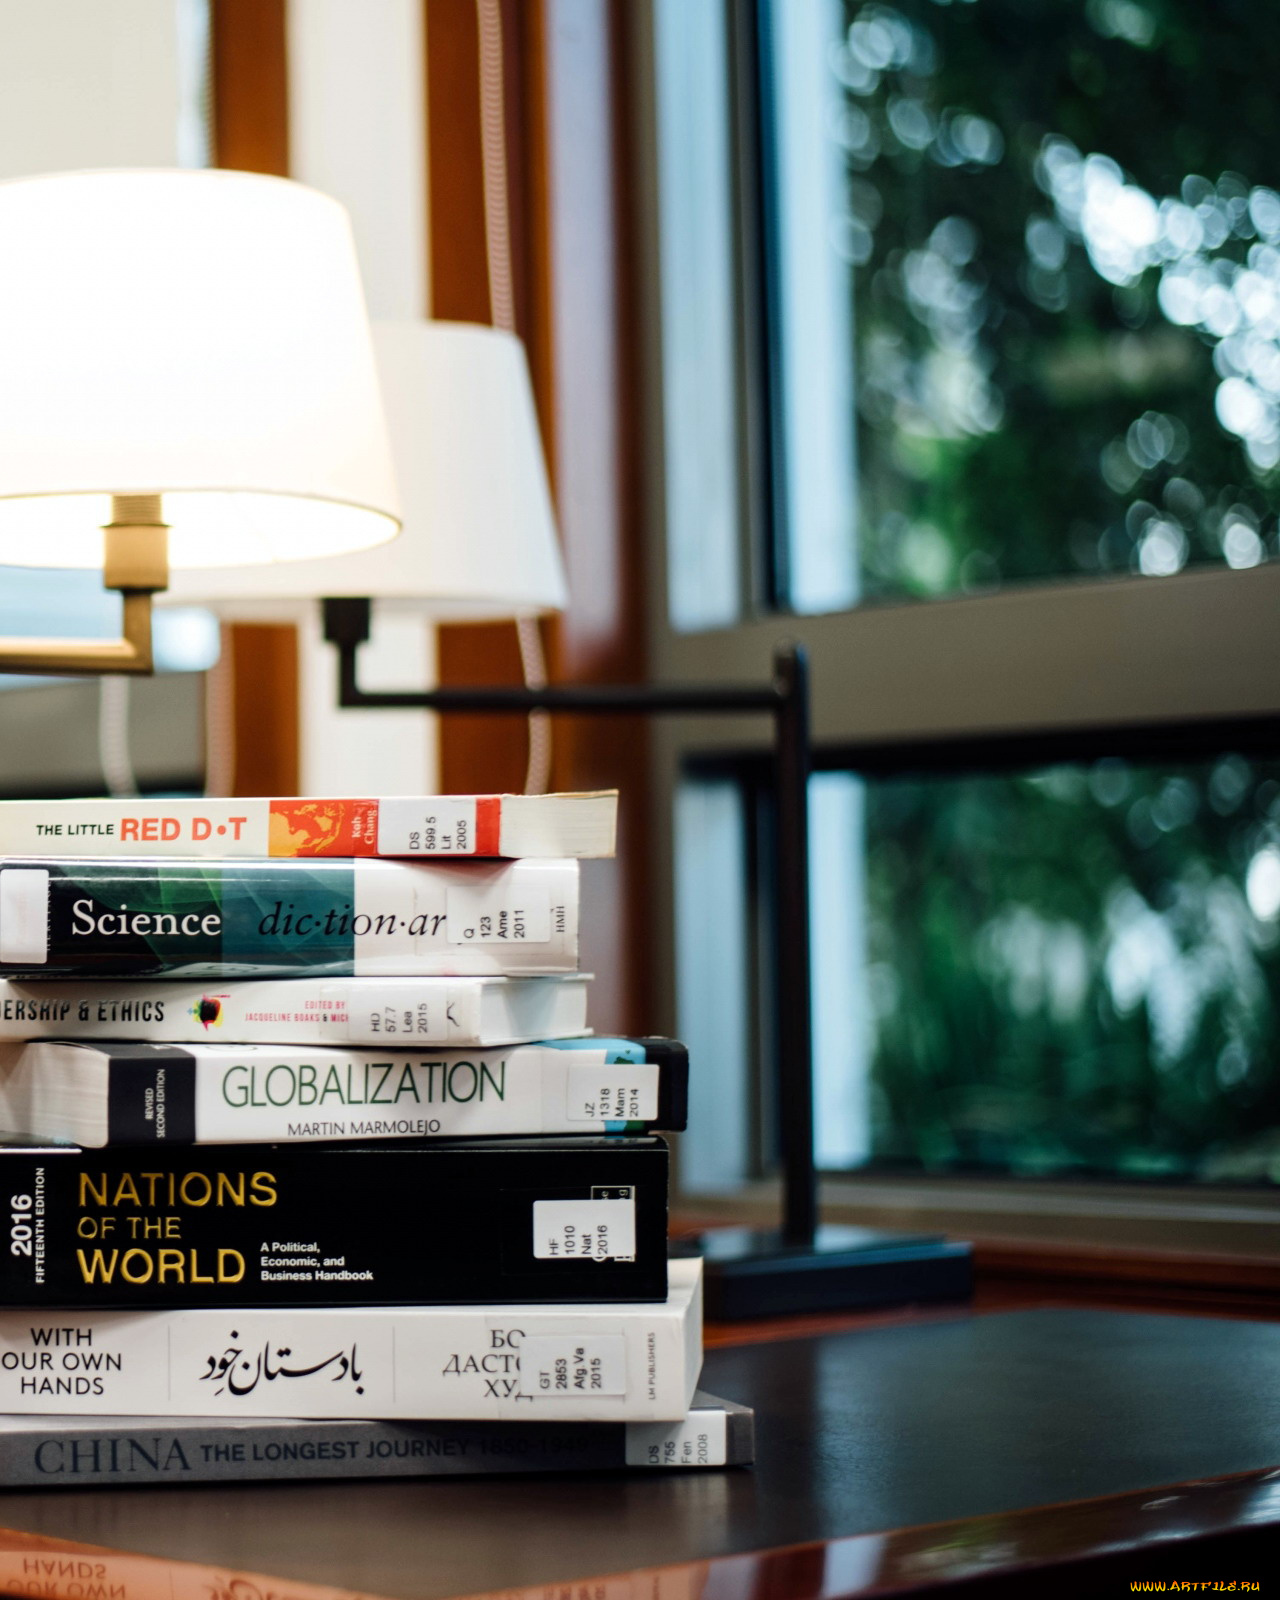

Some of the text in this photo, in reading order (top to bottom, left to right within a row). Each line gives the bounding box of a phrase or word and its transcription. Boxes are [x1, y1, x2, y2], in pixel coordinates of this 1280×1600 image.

[36, 824, 63, 836] THE
[68, 824, 114, 835] LITTLE
[120, 818, 181, 841] RED
[351, 816, 362, 838] Koh
[363, 810, 378, 845] Chang
[456, 820, 467, 850] 2005
[409, 832, 420, 850] DS
[441, 835, 452, 850] Lit
[72, 899, 221, 936] Science
[480, 916, 491, 938] 123
[497, 910, 508, 939] Ame
[514, 909, 525, 938] 2011
[556, 906, 565, 933] HMH
[464, 928, 475, 939] Q
[78, 1002, 89, 1021] &
[97, 1001, 165, 1022] ETHICS
[305, 1000, 345, 1009] EDITED BY
[245, 1013, 291, 1022] JACQUELINE
[294, 1013, 320, 1022] BOAKS
[322, 1013, 328, 1022] &
[371, 1012, 380, 1032] HD
[385, 1006, 396, 1033] 57.7
[402, 1011, 413, 1033] Lea
[417, 1003, 428, 1033] 2015
[222, 1061, 506, 1107] GLOBALIZATION
[145, 1087, 154, 1120] REVISED
[156, 1068, 165, 1138] SECOND EDITION
[585, 1102, 595, 1118] JZ
[600, 1088, 610, 1117] 1318
[615, 1088, 625, 1118] Mam
[630, 1088, 639, 1118] 2014
[287, 1119, 441, 1137] MARTIN MARMOLEJO
[78, 1171, 278, 1207] NATIONS
[11, 1194, 32, 1256] 2016
[35, 1167, 45, 1284] FIFTEENTH EDITION
[77, 1216, 182, 1239] OF THE
[260, 1241, 320, 1254] A Political,
[549, 1238, 559, 1255] HF
[564, 1225, 575, 1255] 1010
[581, 1234, 592, 1255] Nat
[597, 1225, 608, 1255] 2016
[77, 1248, 246, 1284] WORLD
[260, 1256, 345, 1268] Economic, and
[260, 1270, 374, 1281] Business Handbook
[30, 1328, 92, 1346] WITH
[1, 1352, 122, 1371] OUR OWN
[647, 1332, 656, 1400] LM PUBLISHERS
[539, 1371, 550, 1389] GT
[555, 1358, 568, 1389] 2853
[590, 1358, 602, 1389] 2015
[21, 1376, 104, 1395] HANDS
[34, 1437, 192, 1475] CHINA
[200, 1444, 246, 1462] THE
[253, 1441, 360, 1461] LONGEST
[366, 1439, 470, 1459] JOURNEY
[648, 1445, 659, 1464] DS
[664, 1441, 676, 1464] 755
[681, 1441, 692, 1464] Fen
[697, 1433, 708, 1464] 2008
